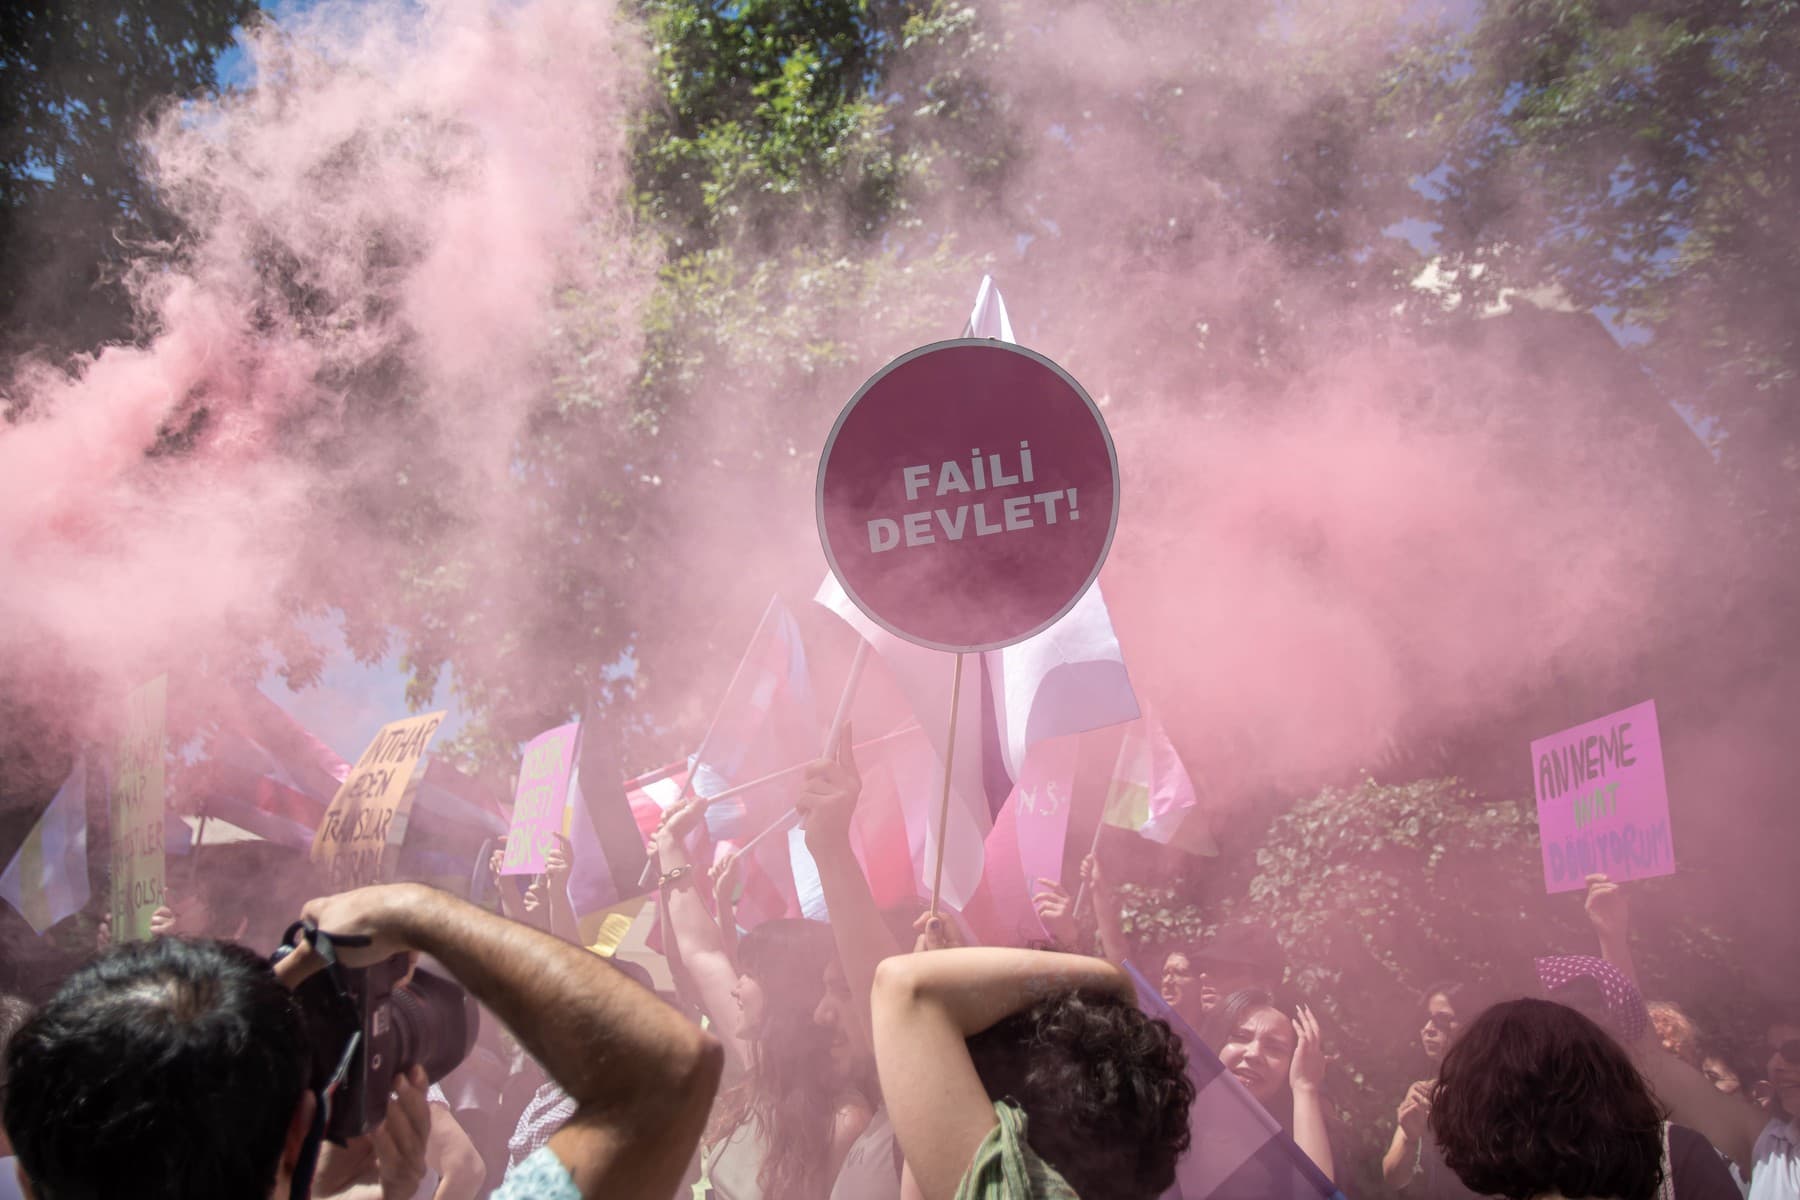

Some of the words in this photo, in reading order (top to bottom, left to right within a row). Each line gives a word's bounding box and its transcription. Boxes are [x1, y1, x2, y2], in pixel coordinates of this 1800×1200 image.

[903, 440, 1034, 501] FAİLİ
[867, 487, 1080, 553] DEVLET!
[1539, 722, 1637, 801] ANNEME
